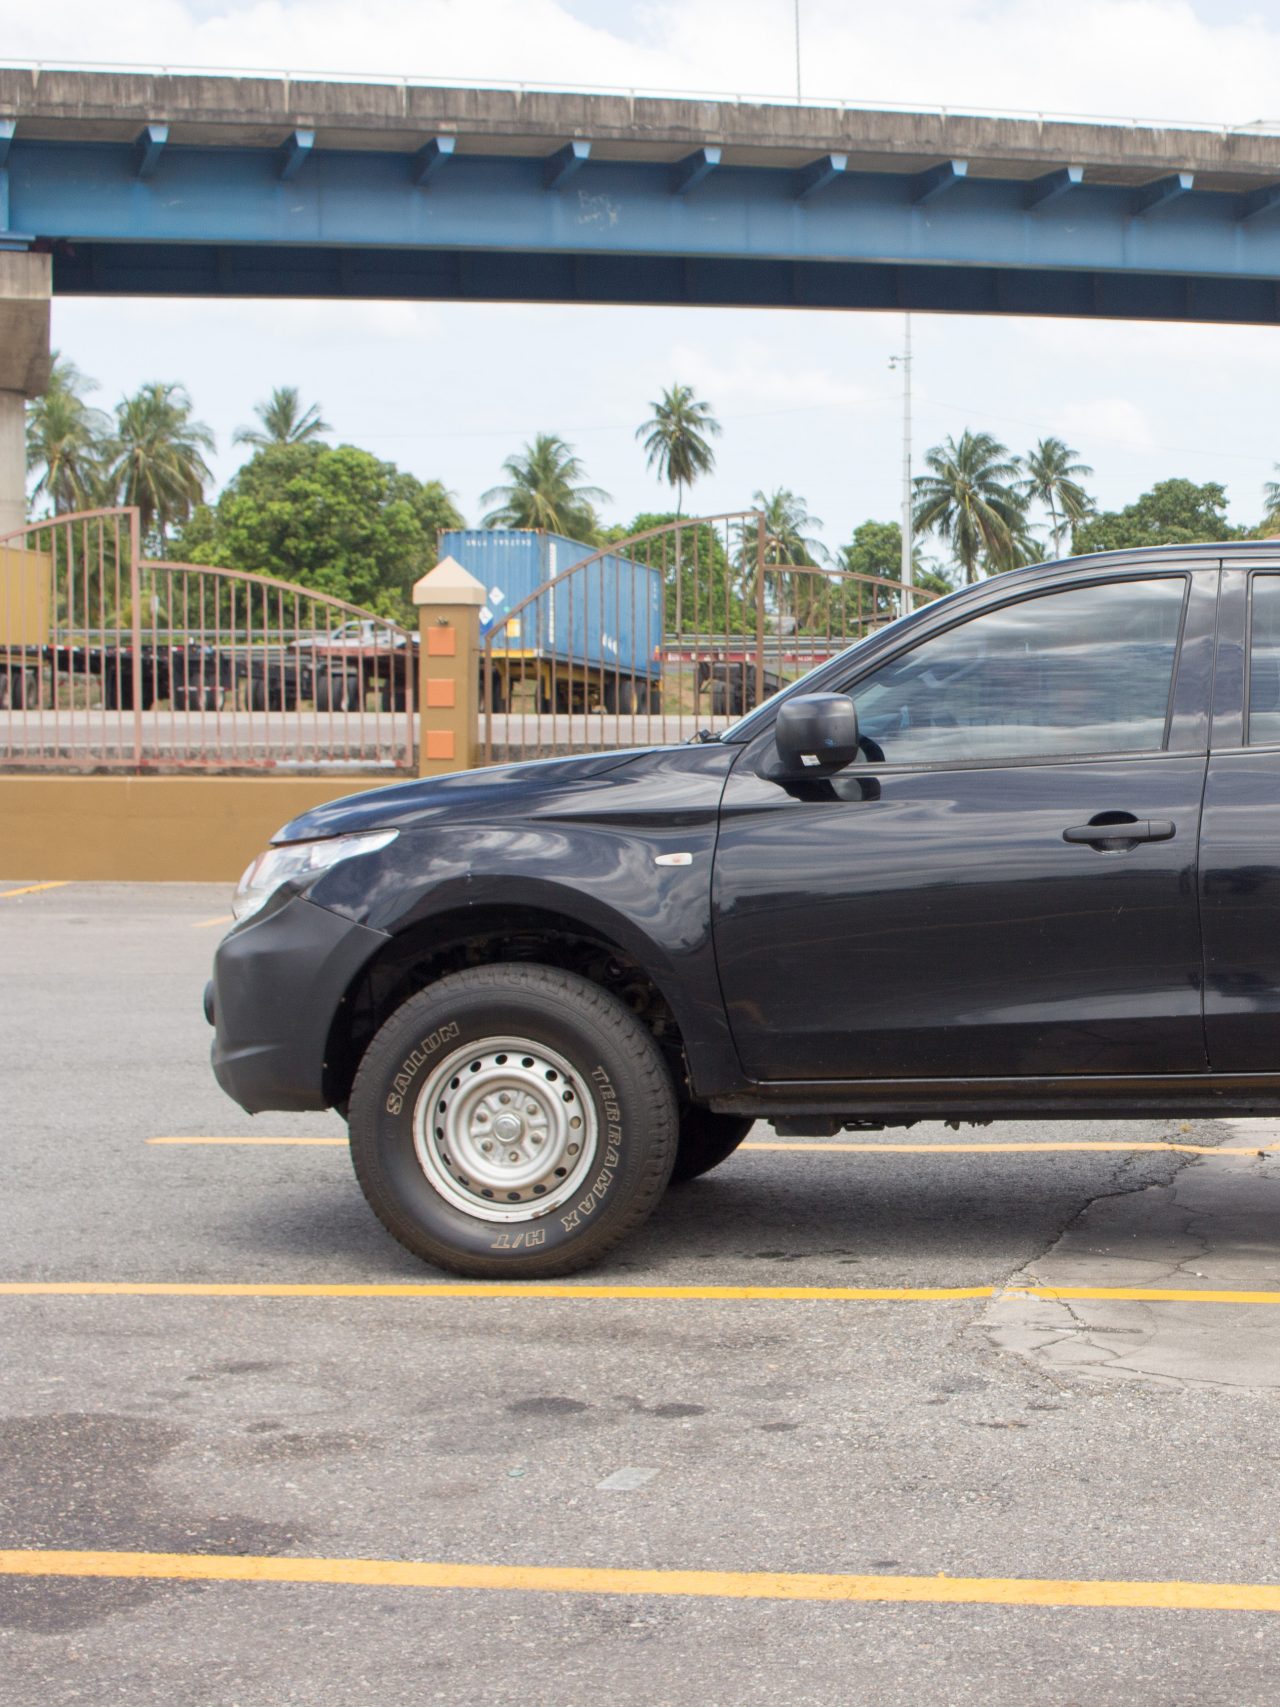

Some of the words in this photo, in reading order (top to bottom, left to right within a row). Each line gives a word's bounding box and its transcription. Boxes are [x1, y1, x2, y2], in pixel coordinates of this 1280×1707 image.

[386, 1021, 460, 1115] SAILUN
[560, 1066, 622, 1232] TERRAMAX
[491, 1228, 545, 1249] H/T
